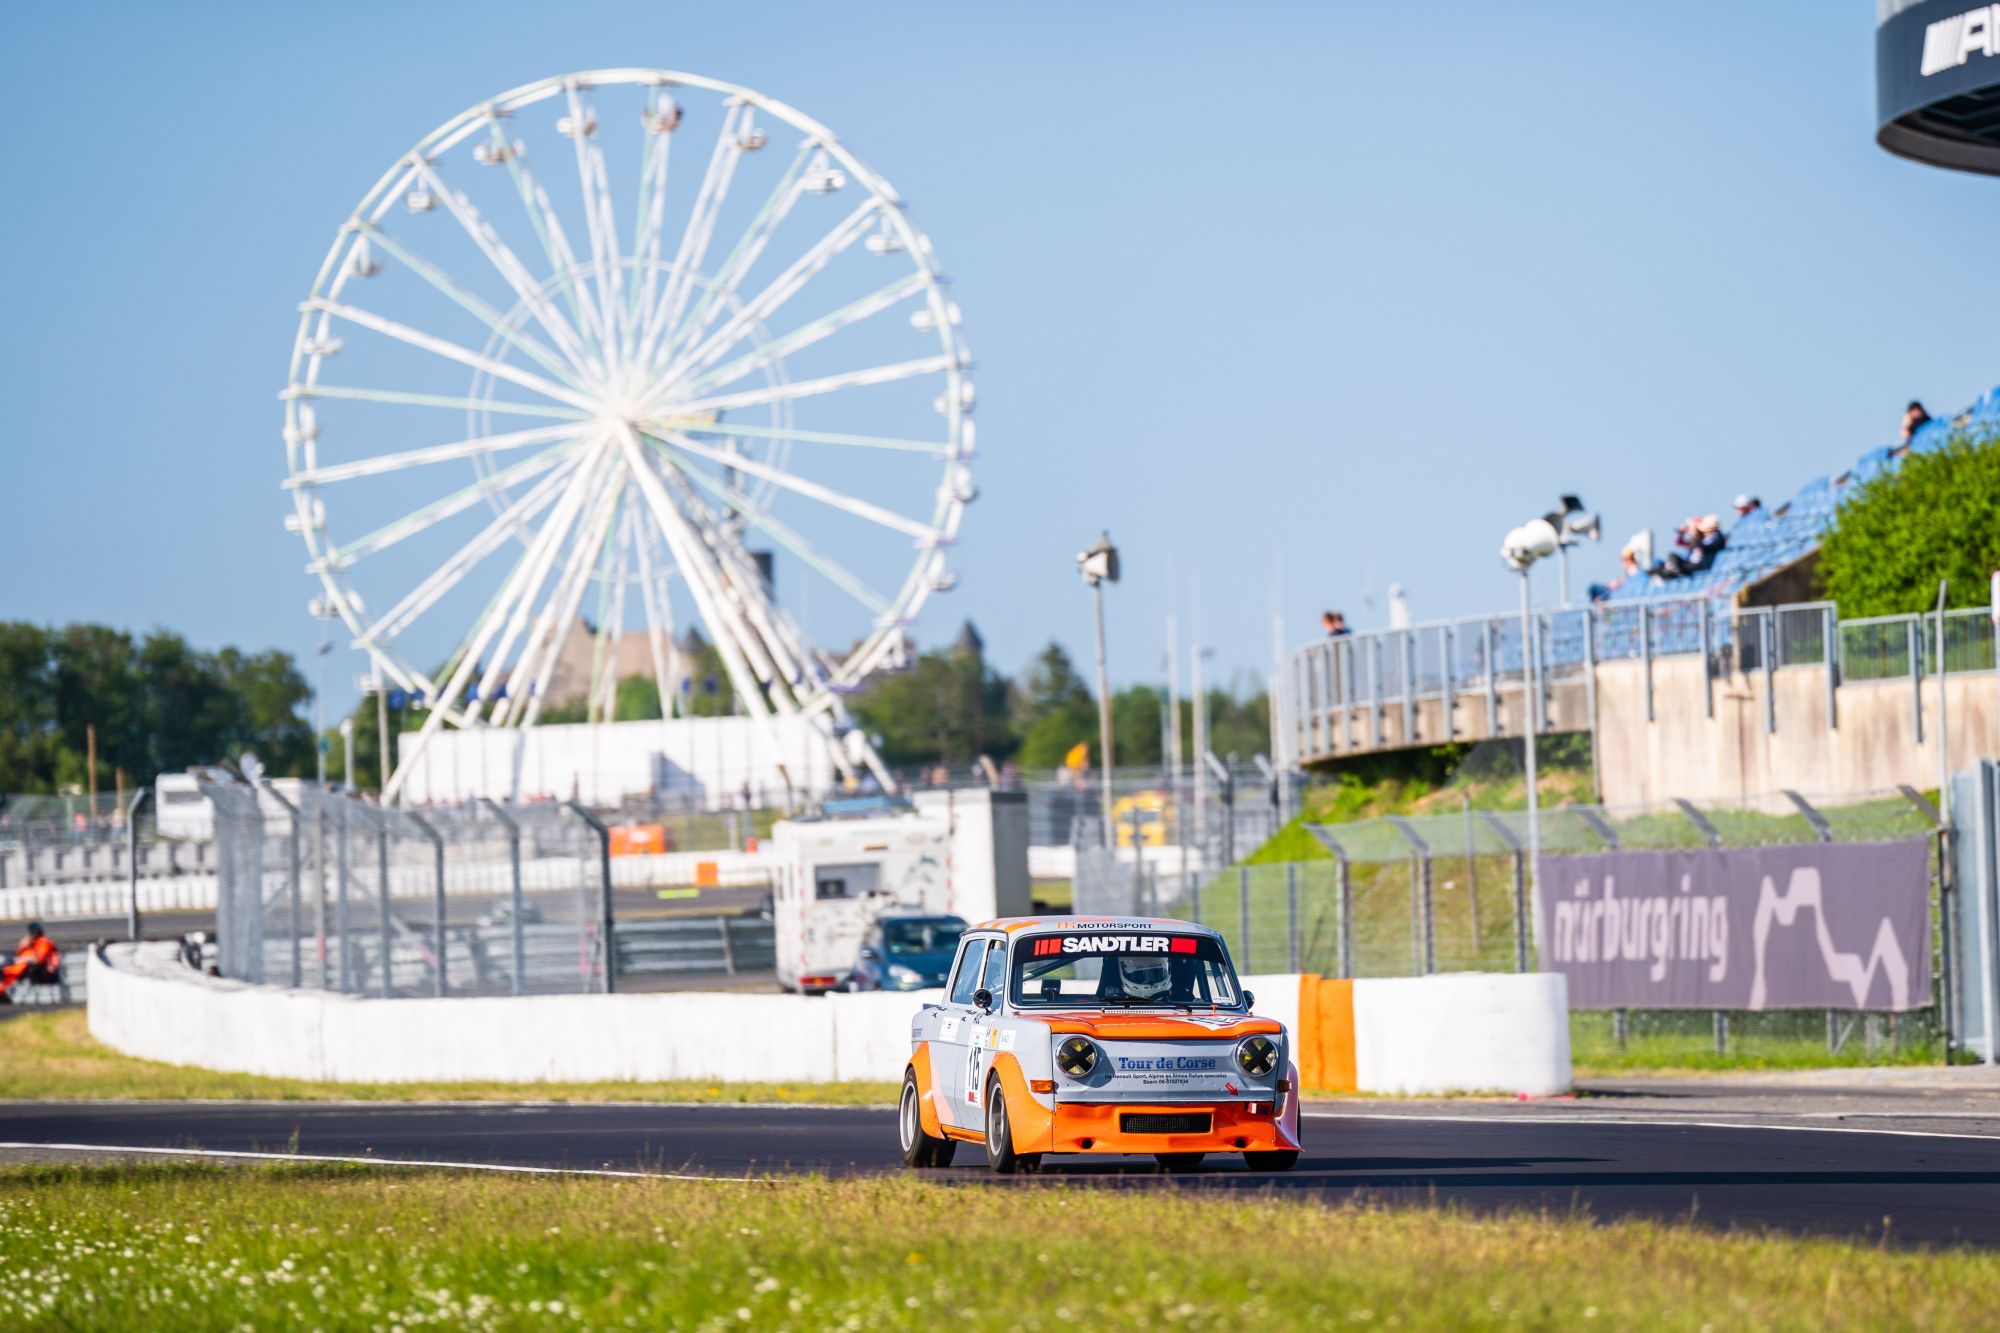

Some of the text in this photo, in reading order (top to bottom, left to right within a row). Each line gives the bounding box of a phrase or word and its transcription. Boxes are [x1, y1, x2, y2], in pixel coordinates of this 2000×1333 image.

[1553, 874, 1729, 983] nürburgring
[1062, 937, 1170, 953] SANDTLER
[969, 1046, 982, 1091] 115
[1118, 1056, 1216, 1069] Tour de Corse
